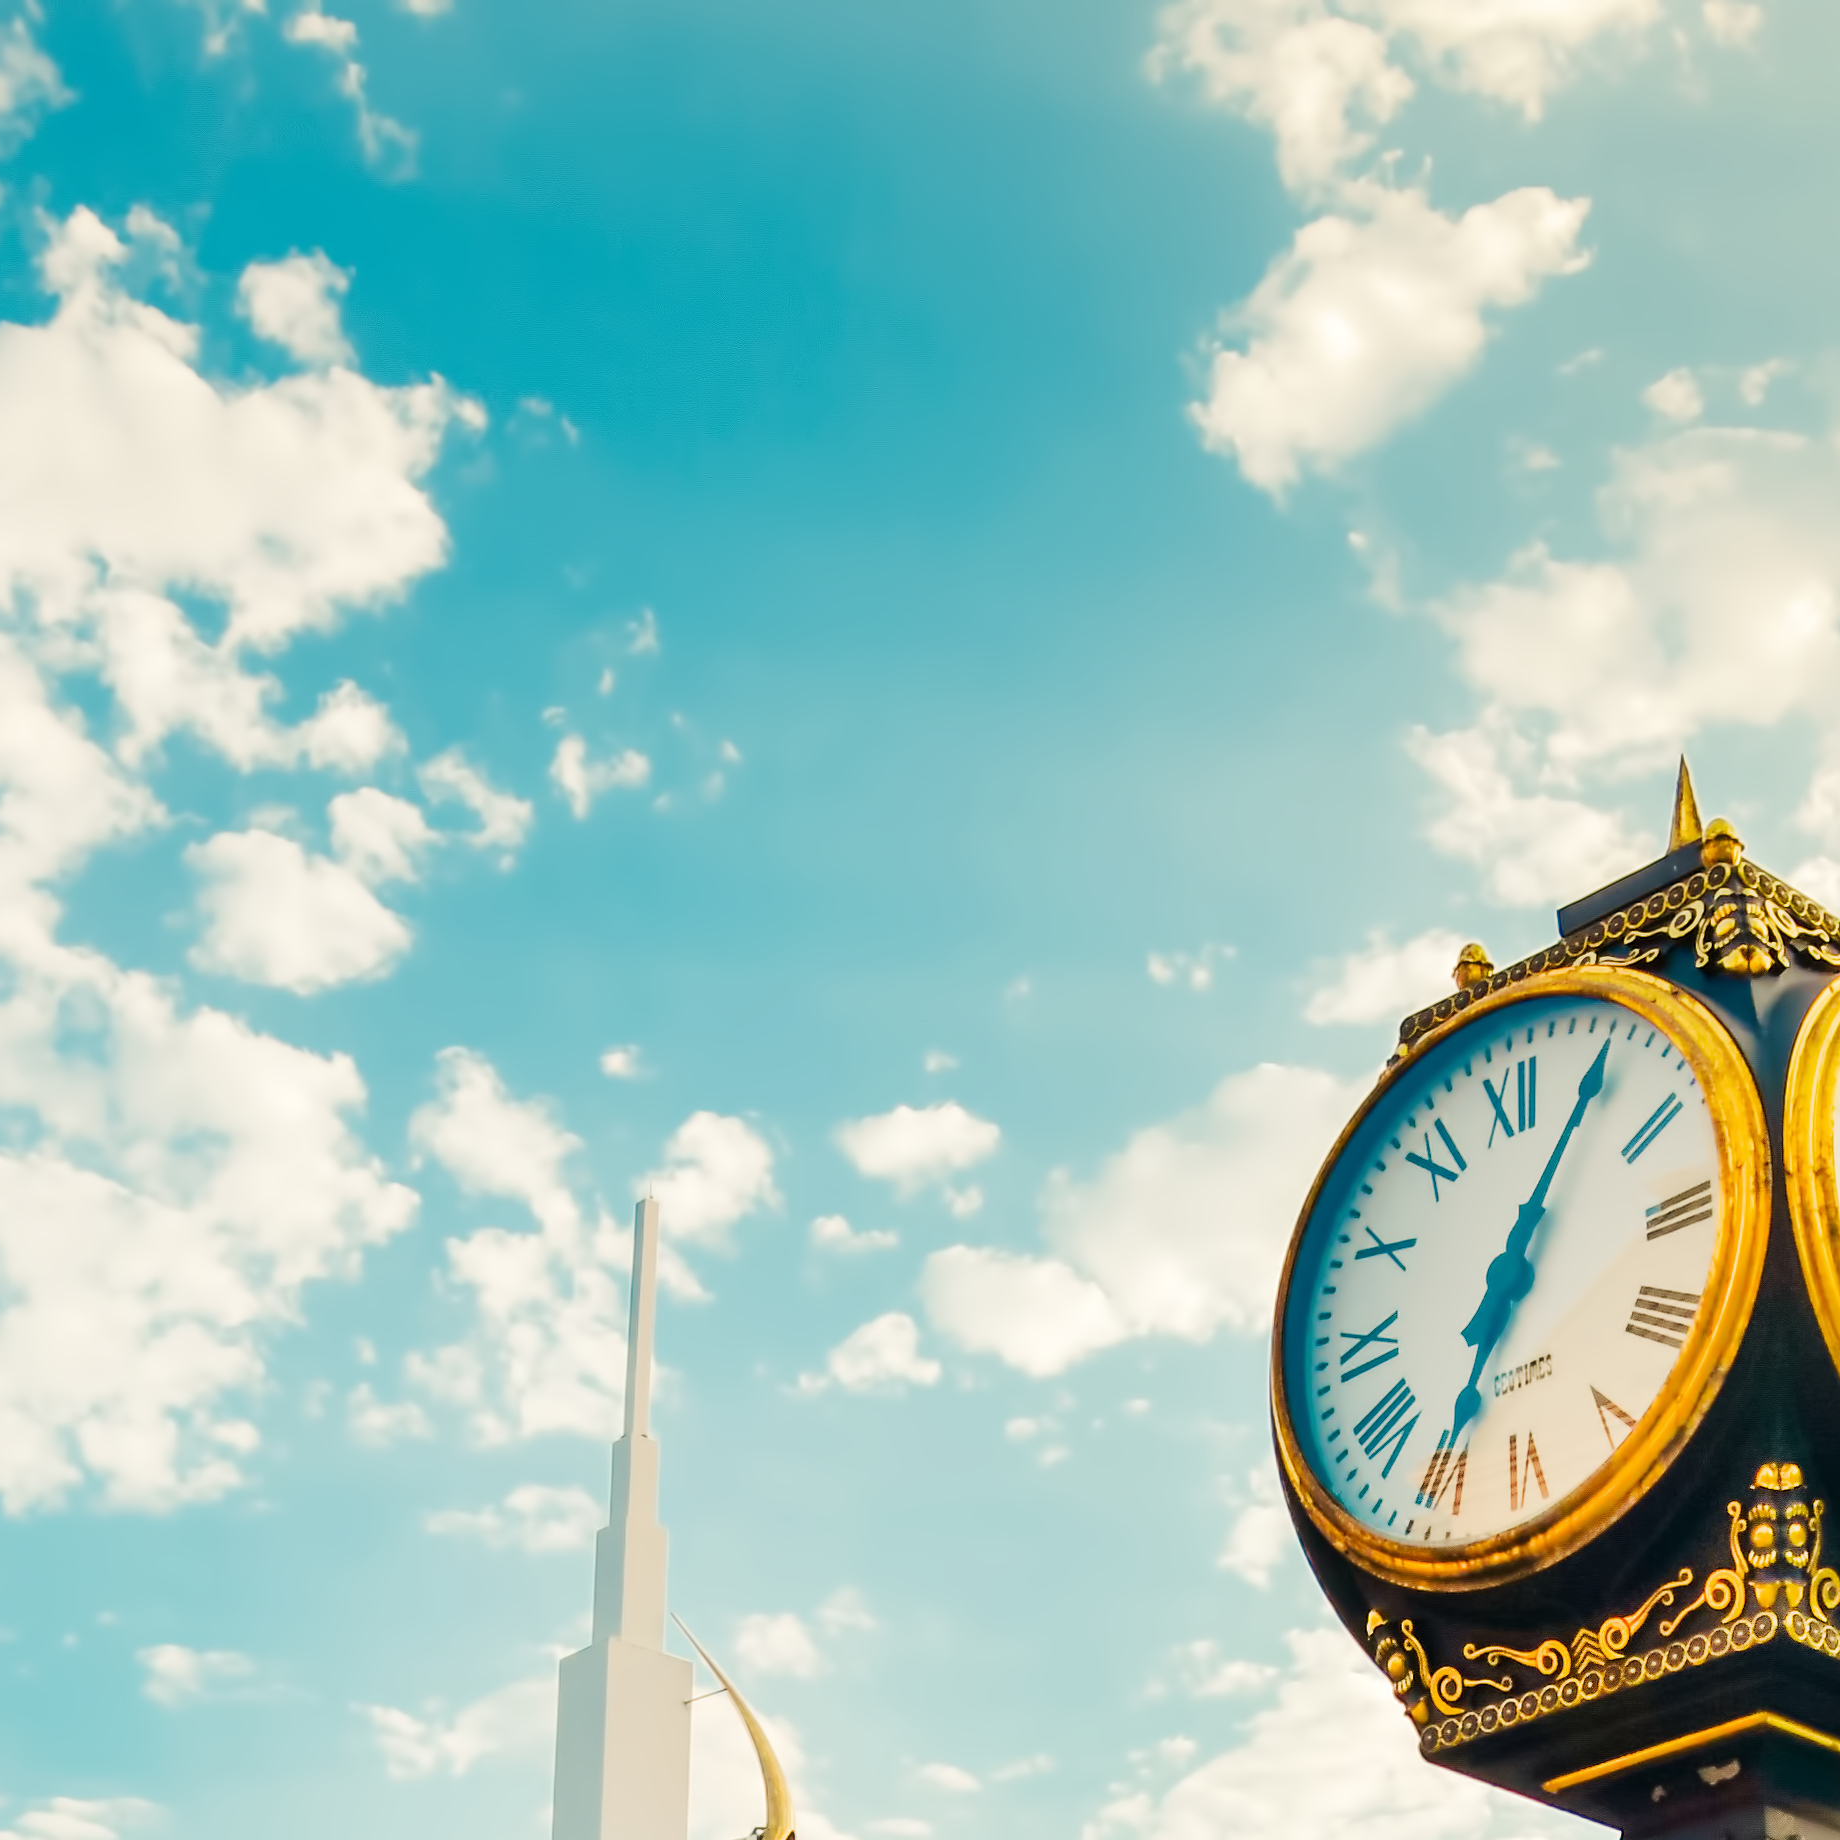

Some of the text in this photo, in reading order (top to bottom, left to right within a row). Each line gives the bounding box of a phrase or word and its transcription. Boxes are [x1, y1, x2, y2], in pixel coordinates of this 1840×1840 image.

[1483, 1056, 1537, 1149] XII
[1621, 1092, 1684, 1164] II
[1405, 1117, 1468, 1203] XI
[1645, 1180, 1713, 1242] III
[1354, 1226, 1418, 1272] X
[1339, 1310, 1399, 1383] IX
[1625, 1285, 1701, 1350] IIII
[1352, 1377, 1422, 1479] VIII
[1509, 1429, 1550, 1512] VI
